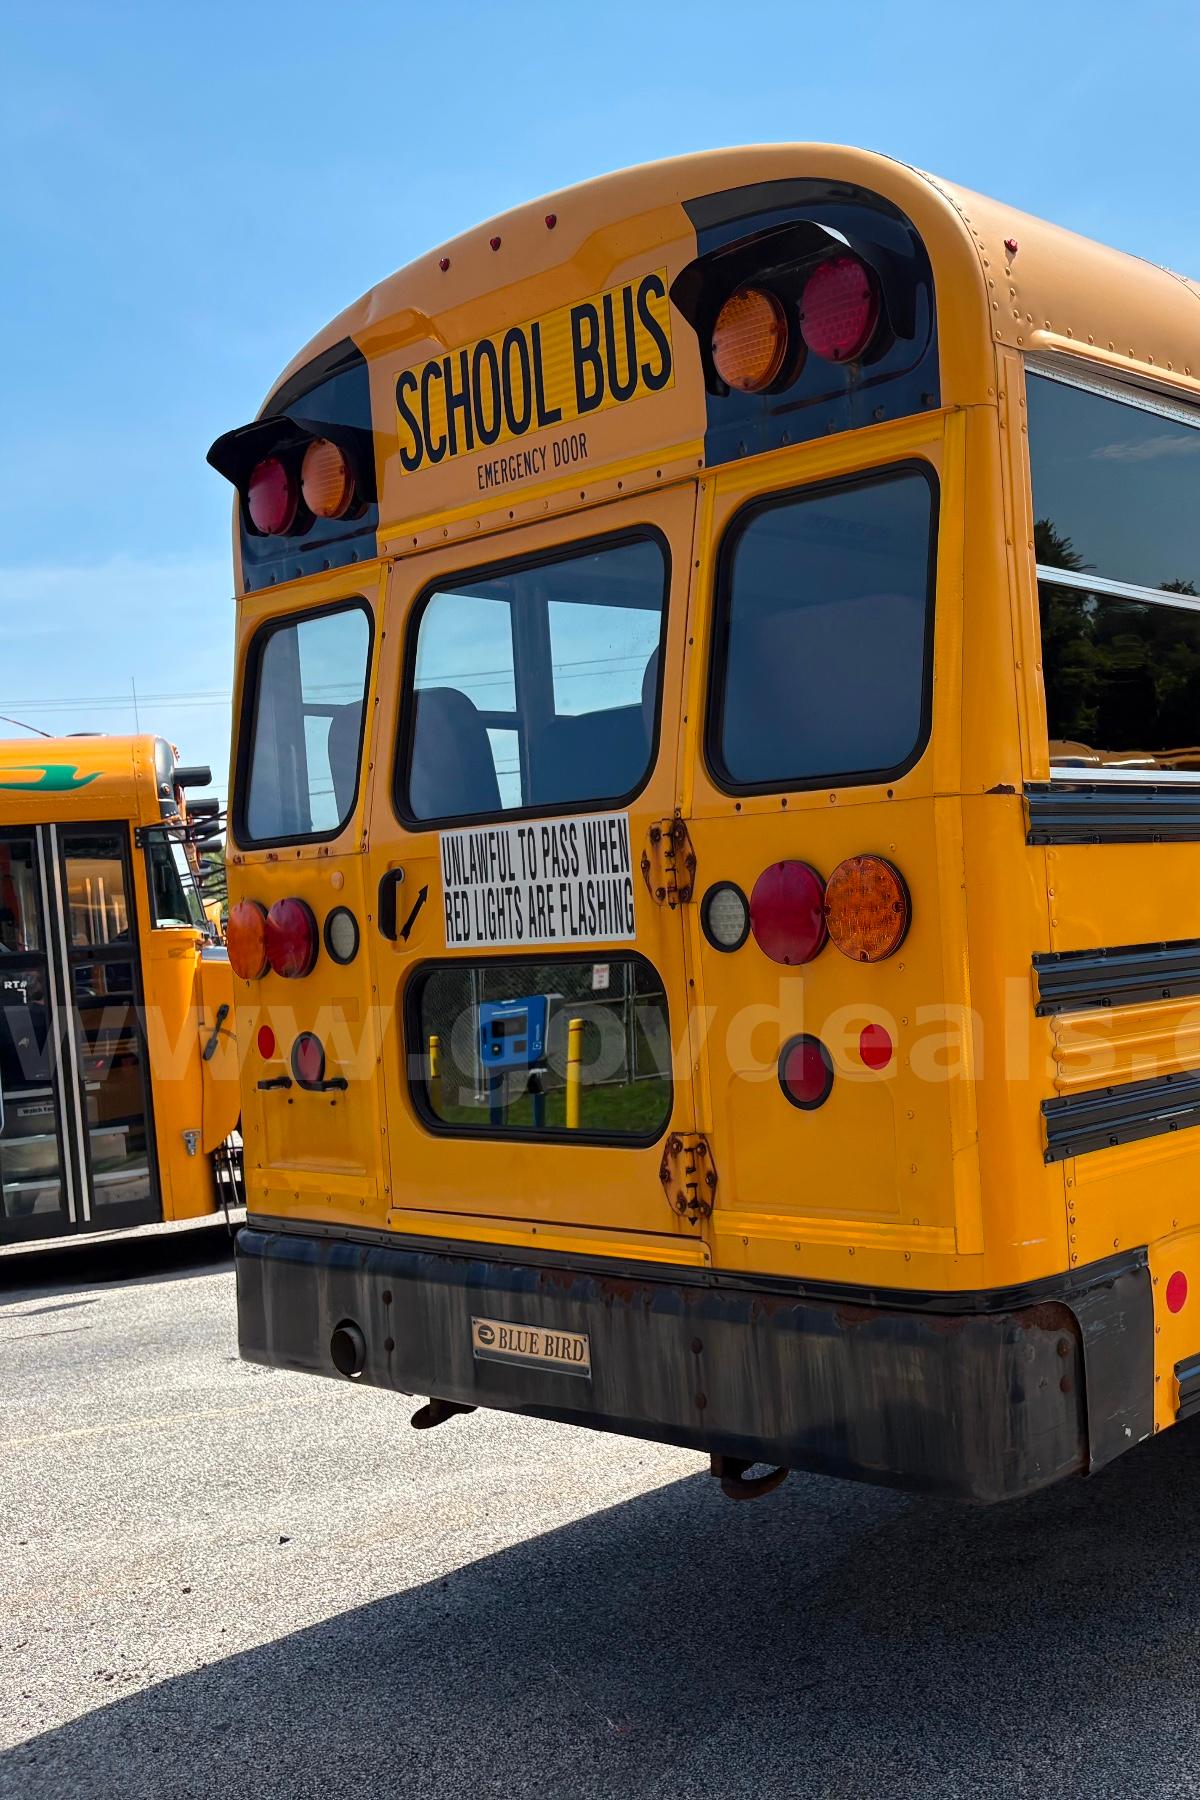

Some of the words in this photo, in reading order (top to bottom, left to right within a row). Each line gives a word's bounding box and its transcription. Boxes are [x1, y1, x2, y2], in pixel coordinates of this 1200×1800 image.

[395, 321, 562, 472] SCHOOL
[570, 274, 672, 415] BUS
[477, 444, 548, 490] EMERGENCY
[553, 432, 588, 468] DOOR
[441, 830, 516, 887] UNLAWFUL
[517, 826, 537, 881] TO
[541, 822, 580, 878] PASS
[582, 818, 630, 875] WHEN
[444, 890, 471, 942] RED
[473, 885, 523, 941] LIGHTS
[528, 884, 556, 938] ARE
[558, 877, 635, 937] FLASHING
[498, 1326, 540, 1355] BLUE
[544, 1334, 585, 1362] BIRD
